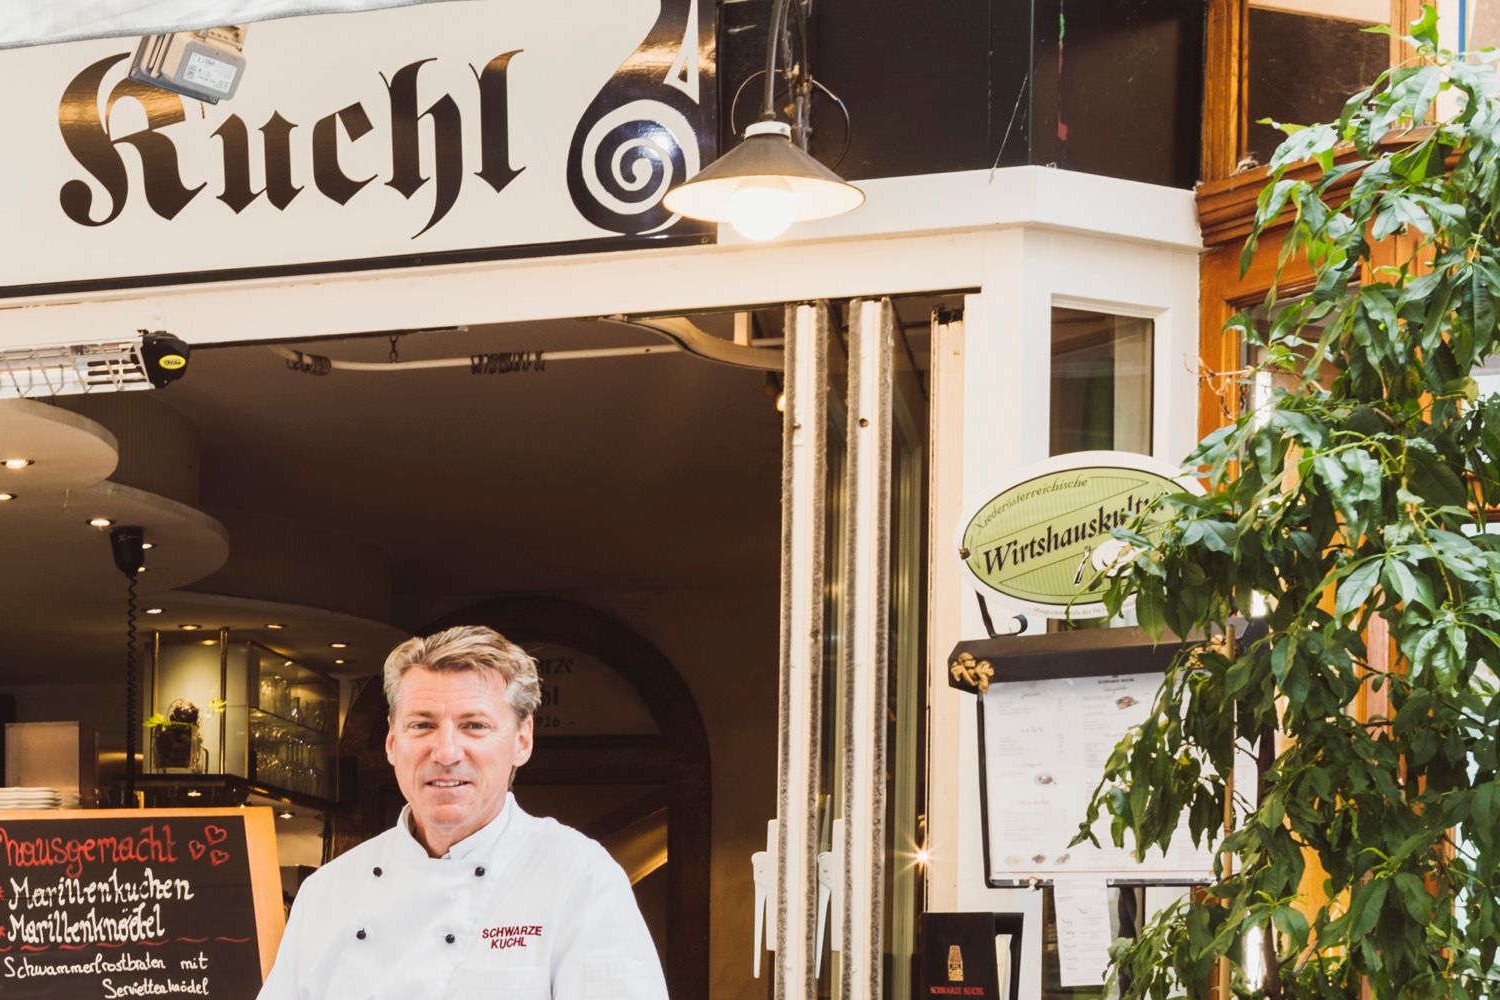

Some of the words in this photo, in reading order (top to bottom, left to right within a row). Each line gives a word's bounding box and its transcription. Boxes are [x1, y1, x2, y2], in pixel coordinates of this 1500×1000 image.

[58, 49, 526, 240] Kuchl
[974, 474, 1088, 533] Niederösterreichische
[983, 490, 1169, 576] Wirtshauskult
[8, 867, 195, 910] Marillenkuchen
[8, 903, 166, 944] Marillenknödel
[482, 925, 543, 939] SCHWARZE
[491, 937, 527, 949] KUCHL
[180, 952, 209, 971] mit
[102, 978, 210, 999] Serviettenknödel
